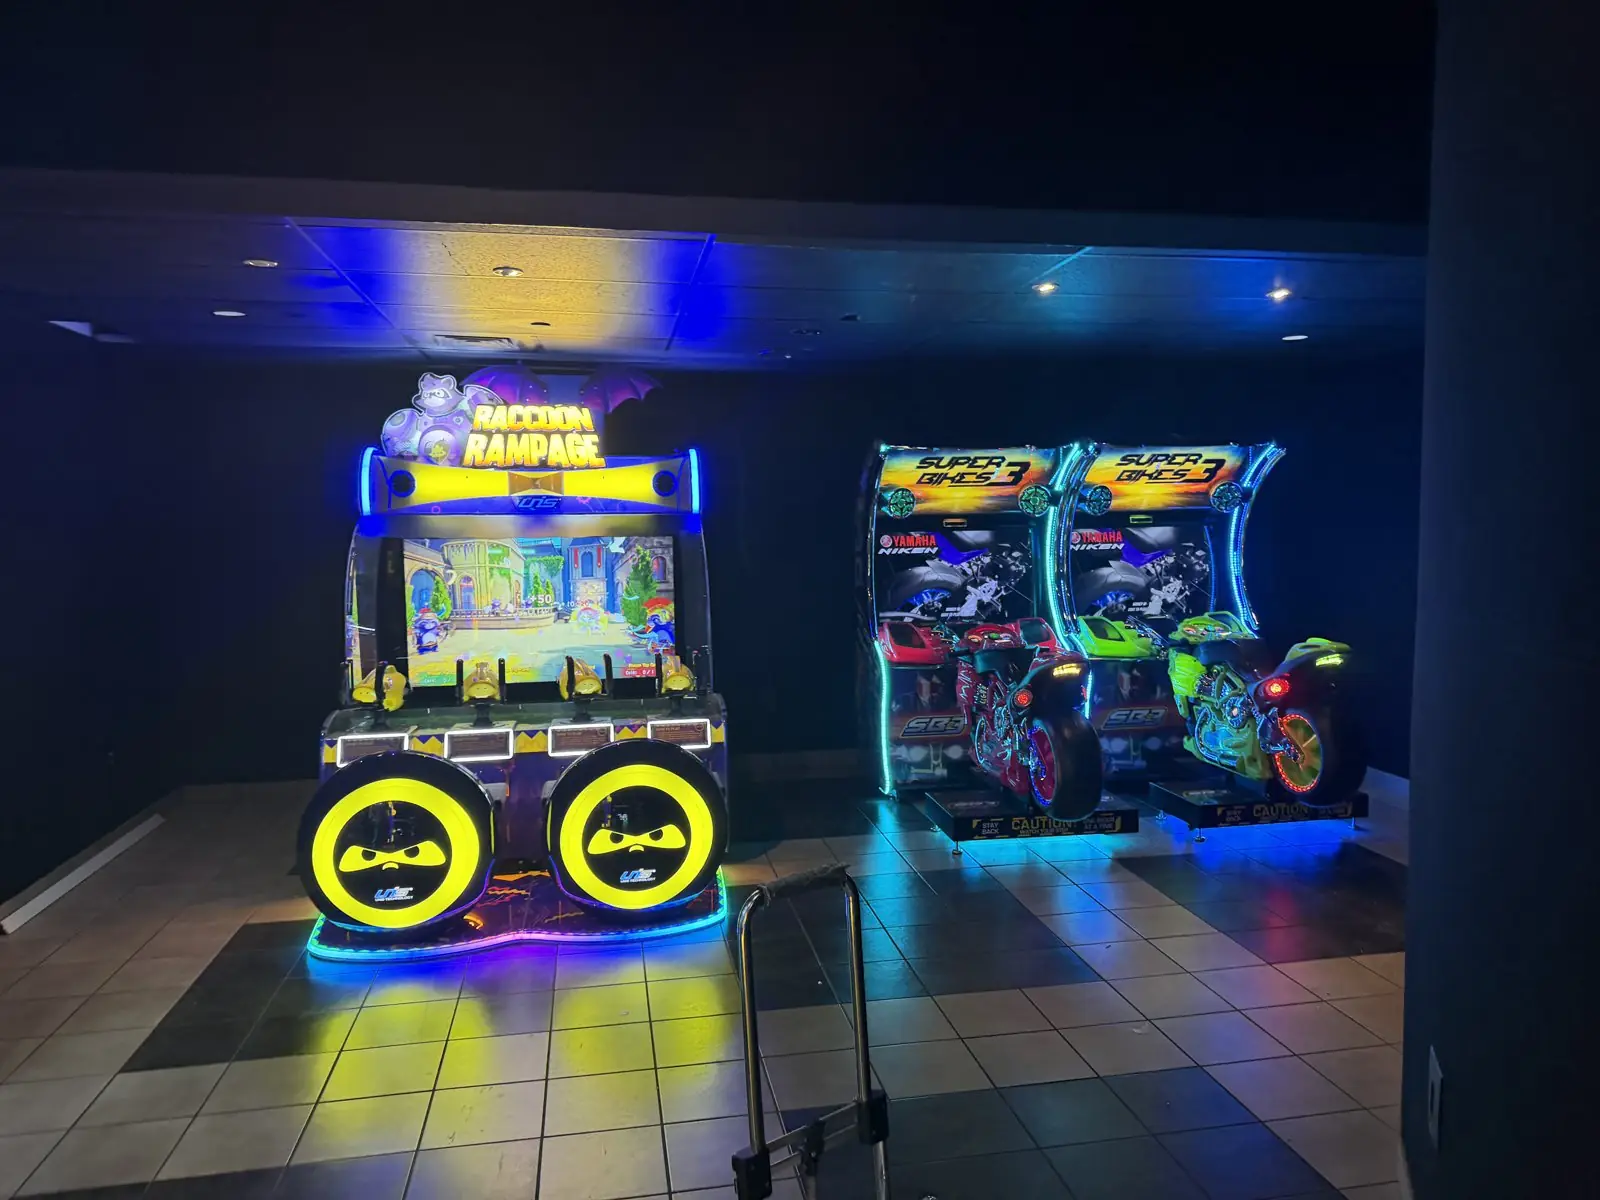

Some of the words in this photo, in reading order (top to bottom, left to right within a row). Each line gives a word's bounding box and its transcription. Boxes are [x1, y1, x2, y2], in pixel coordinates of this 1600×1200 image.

[473, 404, 595, 431] RACCOON
[463, 433, 606, 468] RAMPAGE
[916, 456, 1006, 469] SUPER
[1115, 454, 1202, 466] SUPER
[916, 472, 998, 485] BIKES
[1115, 469, 1192, 482] BIKES
[892, 535, 936, 547] YAMAHA
[1082, 531, 1123, 543] YAMAHA
[878, 547, 938, 555] NIKEN
[1070, 543, 1125, 551] NIKEN
[530, 594, 552, 604] +50
[904, 717, 965, 734] SB3
